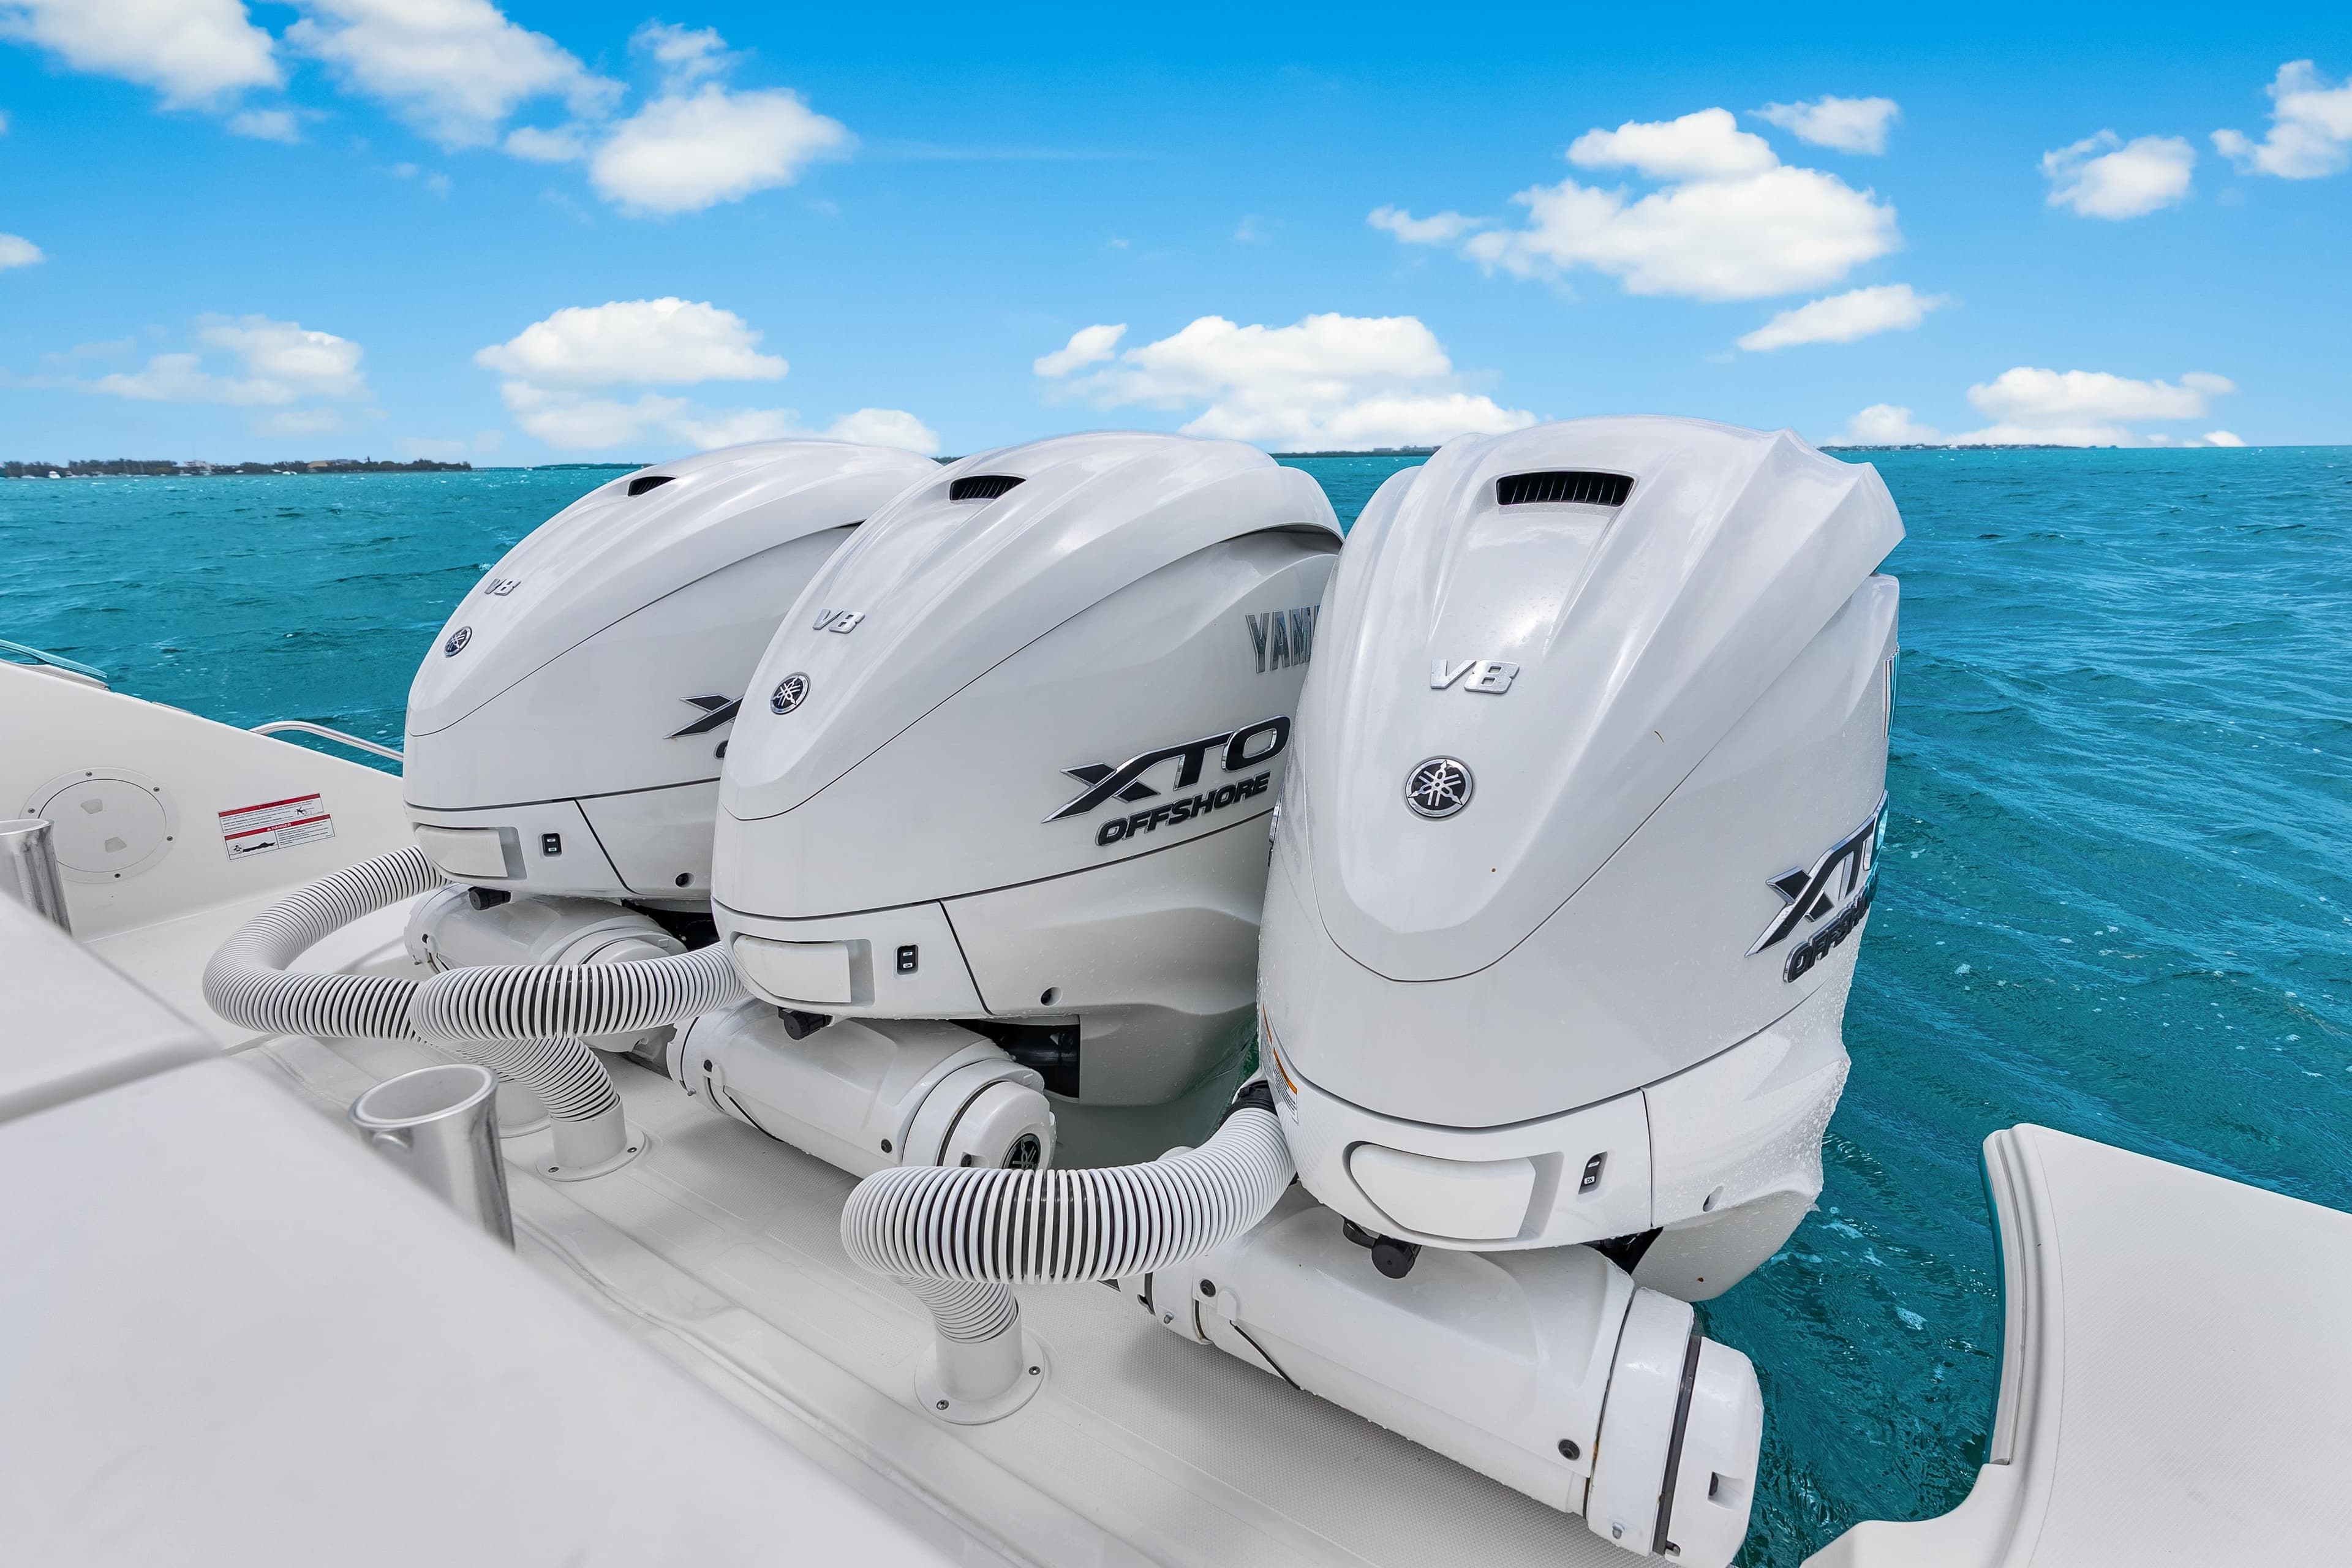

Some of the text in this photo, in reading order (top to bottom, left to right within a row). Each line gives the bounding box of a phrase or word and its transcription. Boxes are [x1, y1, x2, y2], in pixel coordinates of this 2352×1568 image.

[484, 578, 522, 597] V8
[812, 608, 865, 635] V8
[1430, 659, 1520, 695] V8
[1041, 714, 1291, 823] XTO
[1095, 771, 1271, 846] OFFSHORE
